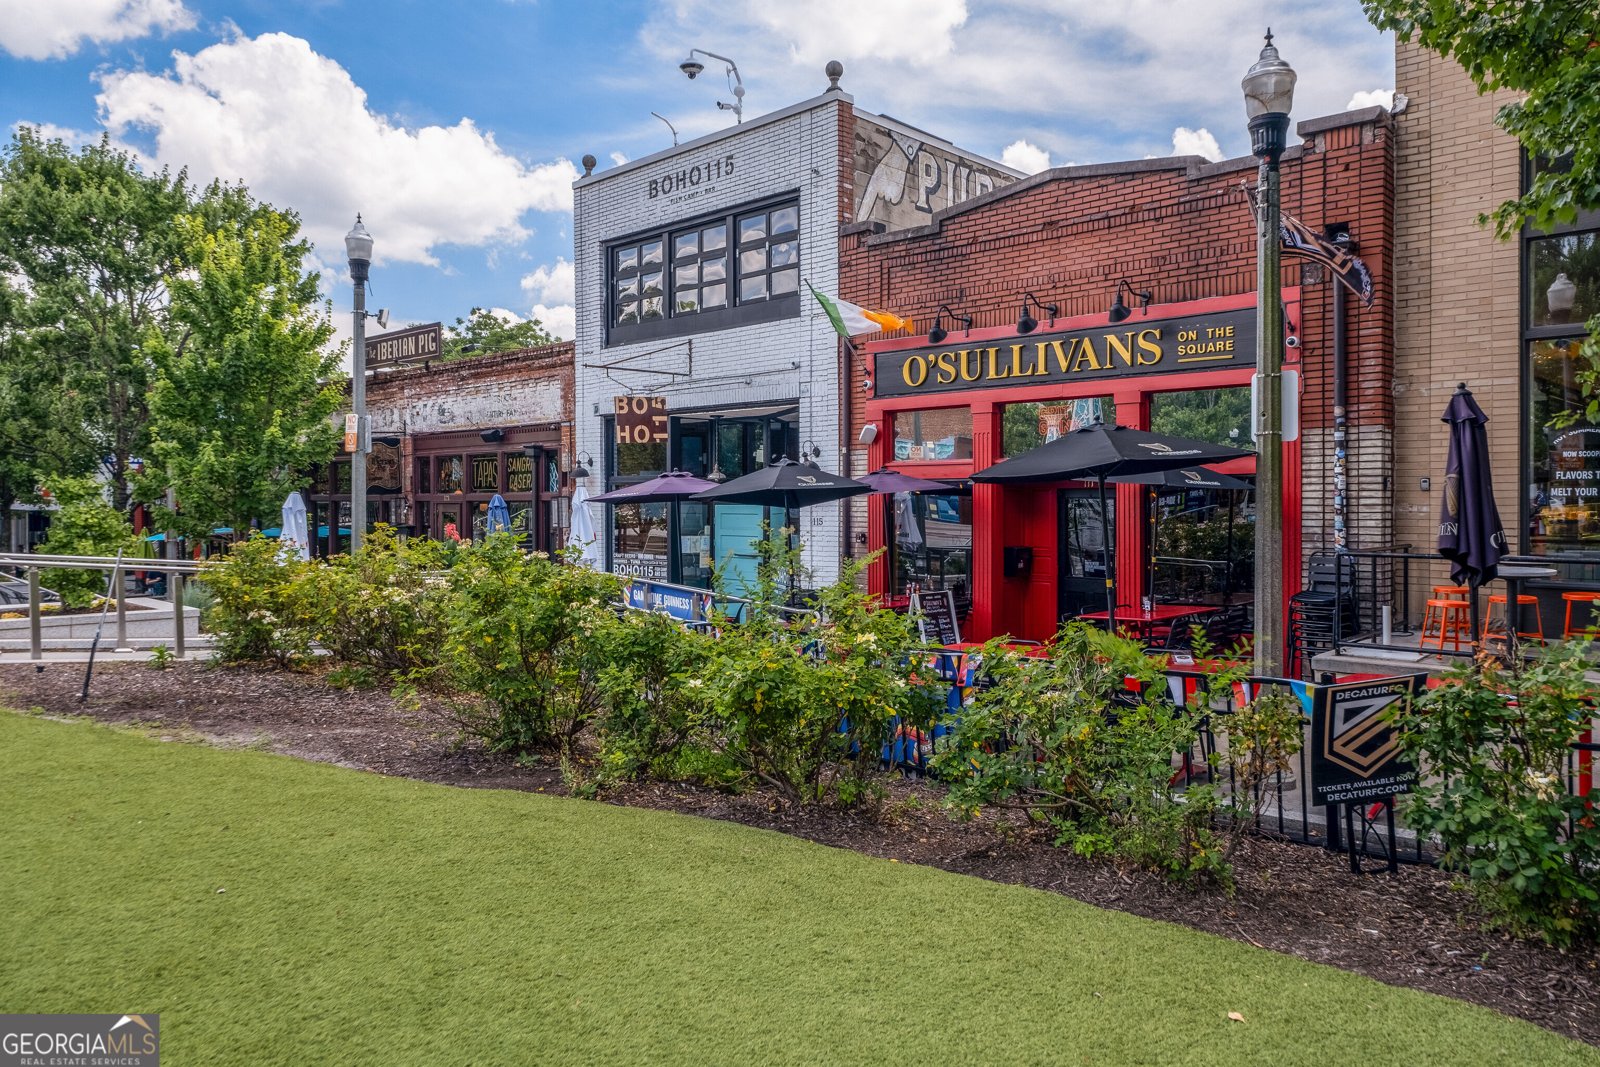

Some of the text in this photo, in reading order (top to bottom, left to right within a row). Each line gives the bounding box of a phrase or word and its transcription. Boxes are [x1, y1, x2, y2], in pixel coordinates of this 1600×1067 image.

[649, 155, 734, 200] BOHO115
[1177, 325, 1234, 342] ON THE
[377, 336, 416, 361] IBERIAN
[418, 332, 437, 354] PIG
[1177, 339, 1234, 356] SQUARE
[902, 328, 1164, 388] O'SULLIVANS
[473, 461, 498, 488] TAPAS
[1555, 471, 1593, 480] FLAVORS
[1551, 488, 1598, 496] MELT YOUR
[813, 517, 824, 526] 115
[614, 565, 654, 577] BOHO115
[663, 594, 690, 610] GUINNESS
[1336, 684, 1404, 700] DECATURFC
[1318, 782, 1352, 792] TICKETS
[1353, 776, 1394, 788] AVAILABLE
[1327, 784, 1408, 801] DECATURFC.COM
